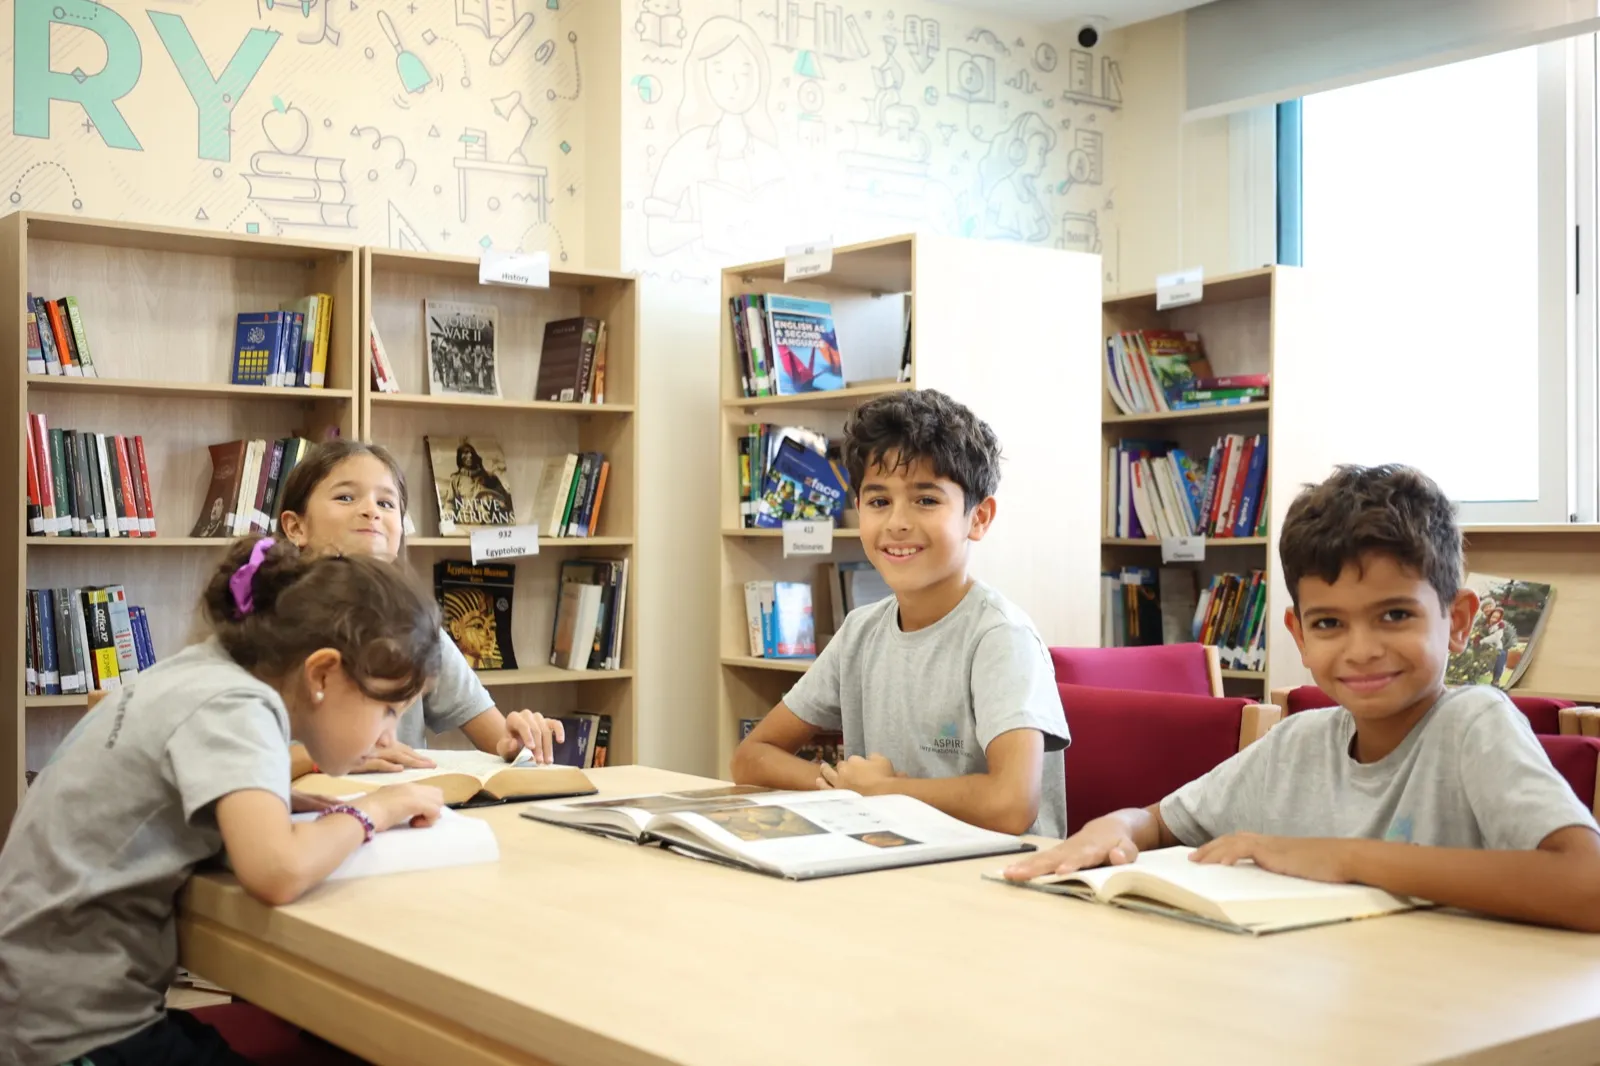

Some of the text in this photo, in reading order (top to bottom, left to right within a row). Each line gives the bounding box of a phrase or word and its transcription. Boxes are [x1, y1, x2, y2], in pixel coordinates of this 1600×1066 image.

[501, 272, 529, 284] History
[441, 315, 486, 330] WORLD
[774, 320, 813, 331] ENGLISH
[814, 324, 826, 333] AS
[444, 328, 481, 342] WAR II
[775, 328, 821, 340] A SECOND
[776, 337, 825, 349] LANGUAGE
[455, 497, 500, 511] NATIVE
[443, 508, 516, 524] AMERICANS
[498, 530, 512, 538] 932
[485, 545, 526, 557] Egyptology
[97, 608, 109, 643] Office XP
[933, 738, 964, 749] ASPIRE
